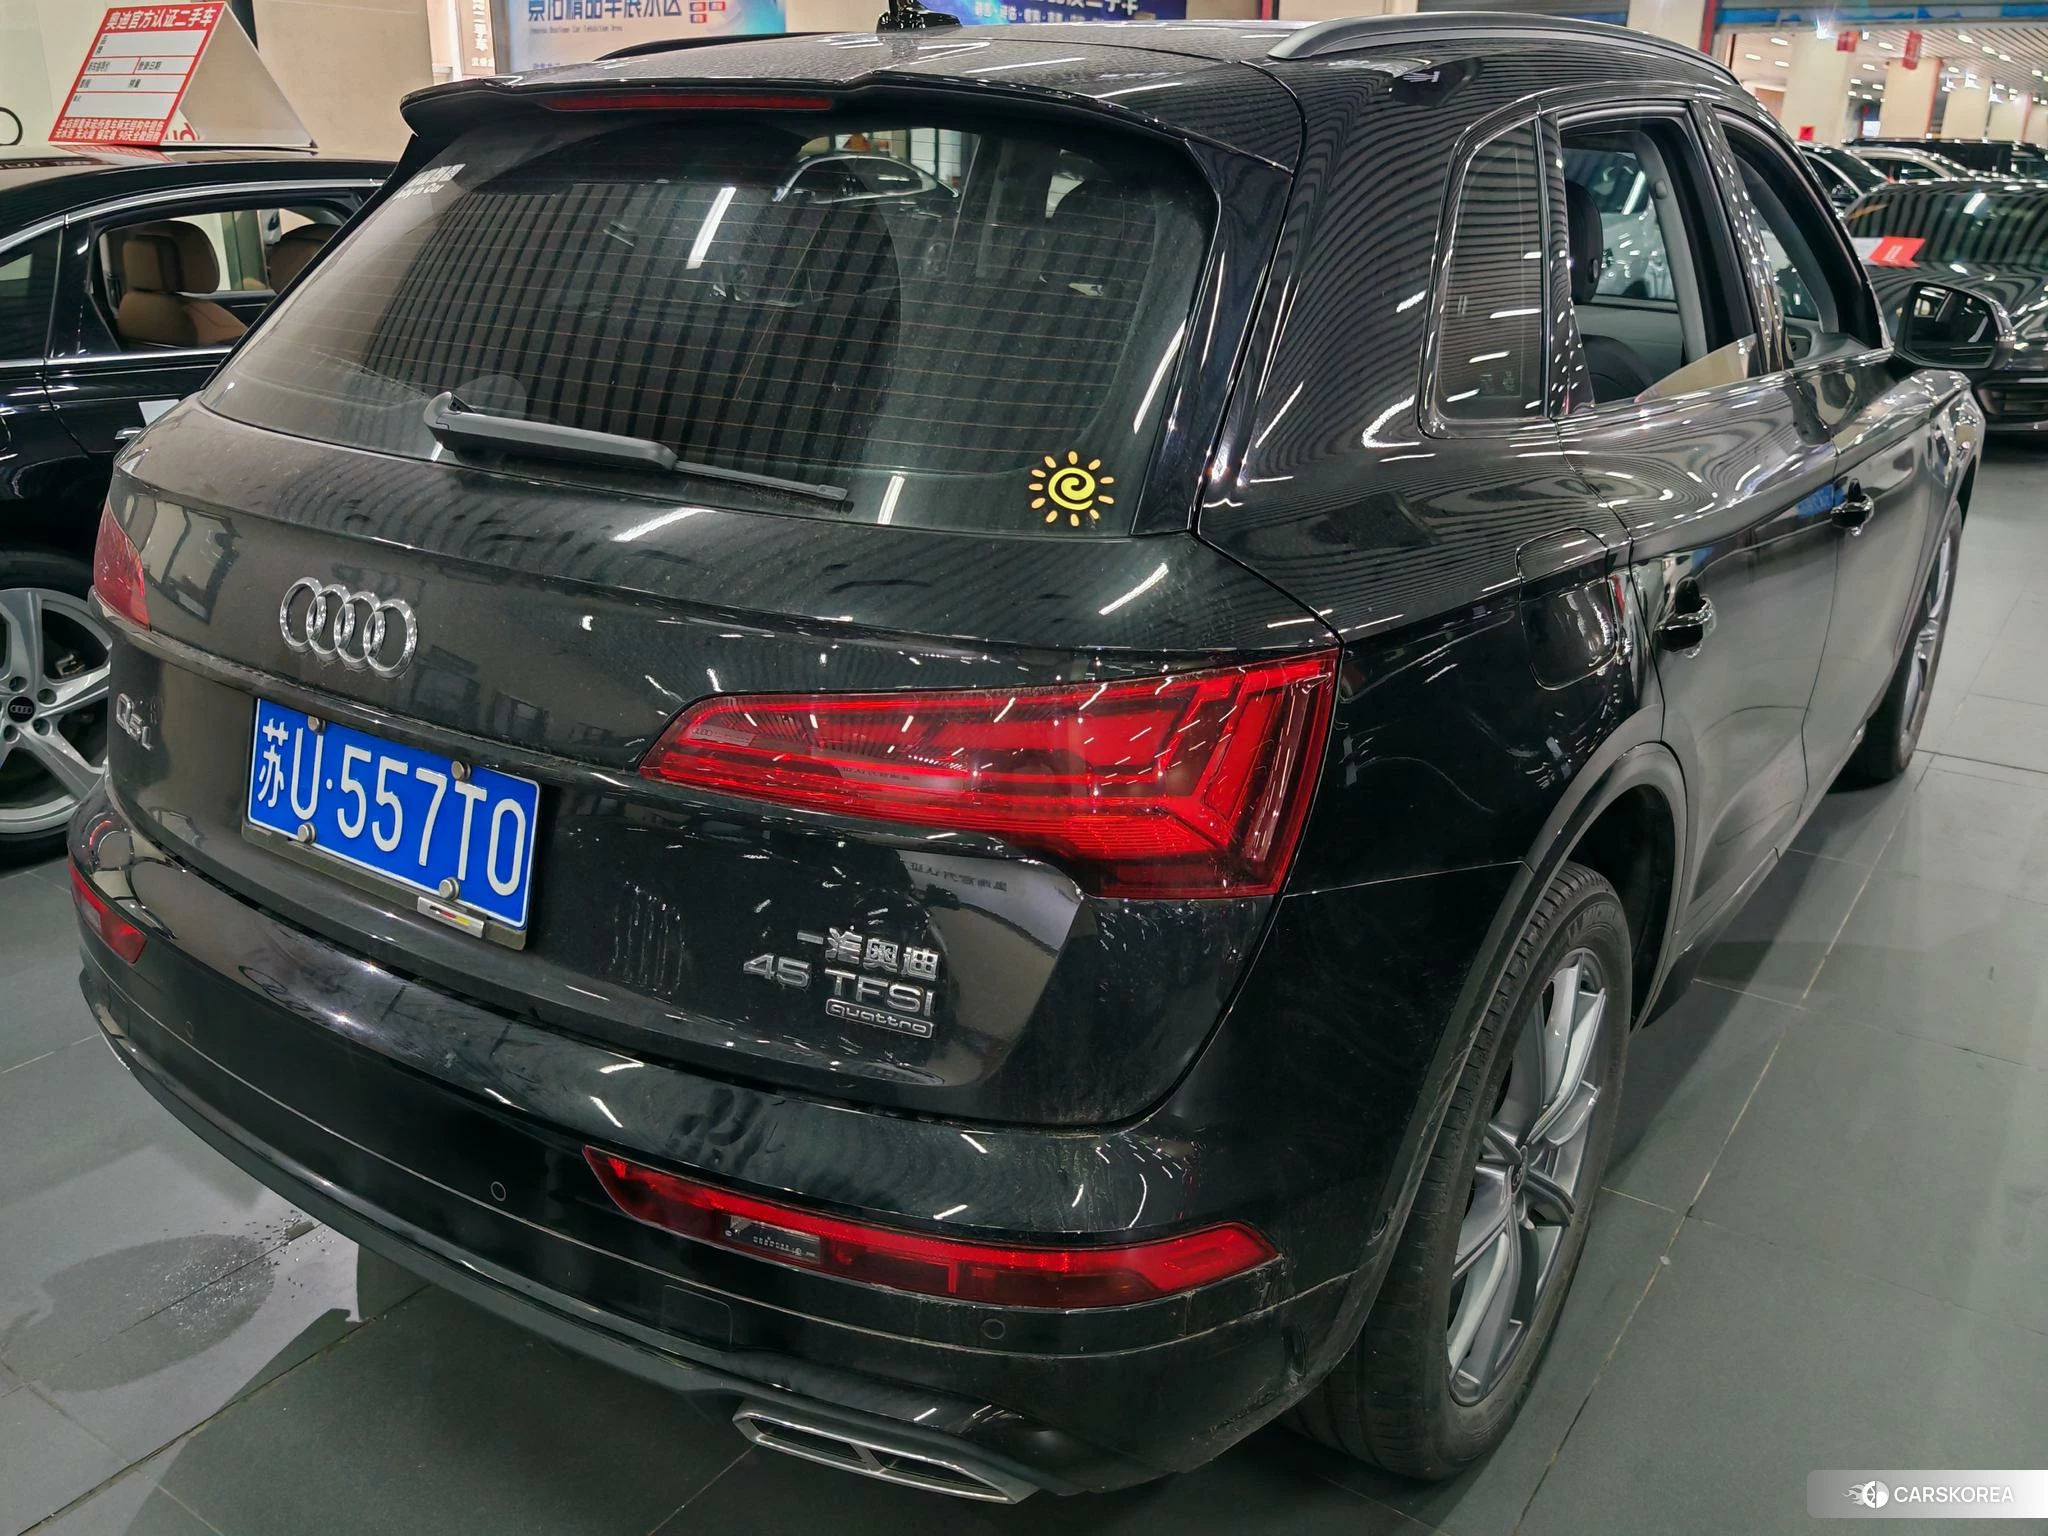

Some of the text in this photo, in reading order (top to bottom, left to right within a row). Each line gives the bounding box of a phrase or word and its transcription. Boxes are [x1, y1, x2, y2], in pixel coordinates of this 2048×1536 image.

[105, 7, 217, 30] 奥迪官方认证二手车
[743, 952, 936, 1017] 45 TFSI
[828, 1003, 929, 1034] quattro
